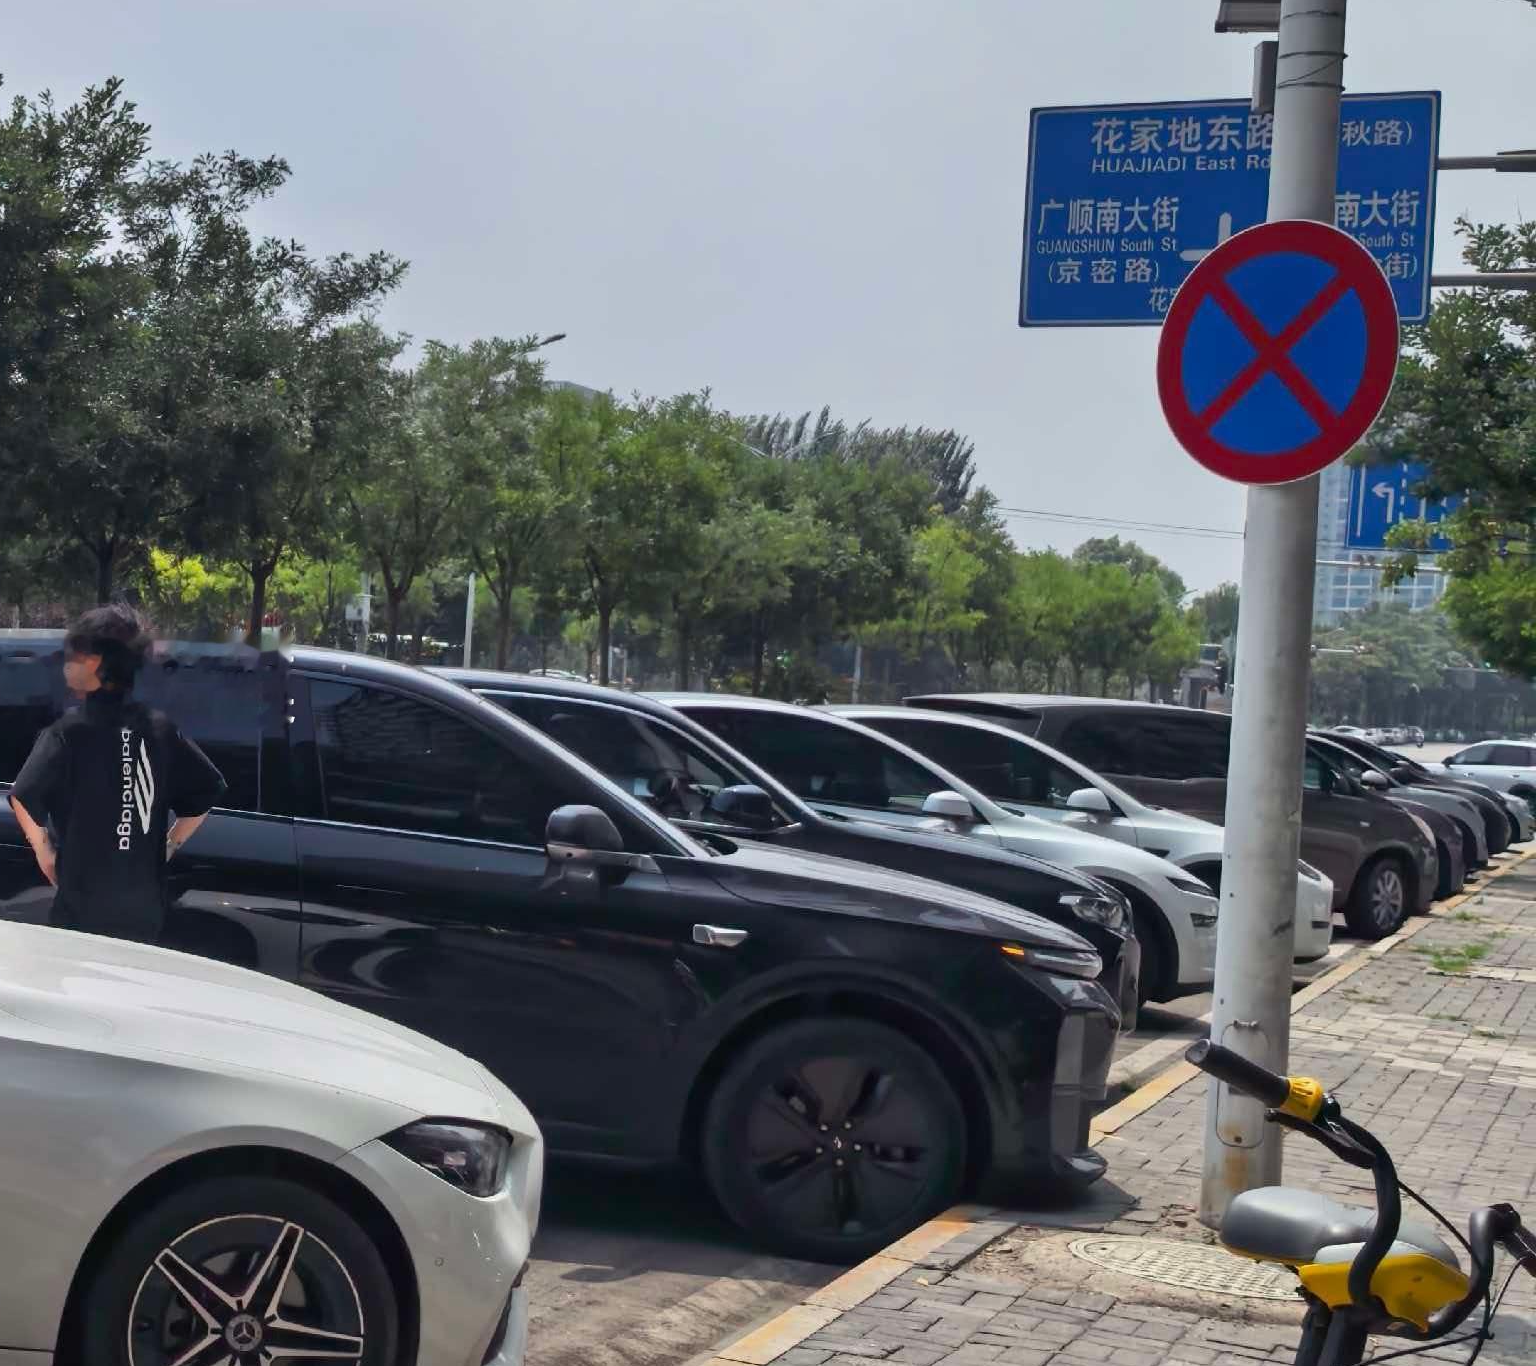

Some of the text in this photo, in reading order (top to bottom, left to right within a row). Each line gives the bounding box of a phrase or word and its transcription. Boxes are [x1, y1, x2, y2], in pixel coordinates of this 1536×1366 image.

[1091, 113, 1273, 155] 花家地东路
[1091, 156, 1187, 174] HUAJIADI
[1195, 154, 1236, 171] East
[1037, 196, 1179, 235] 广顺南大街
[1333, 188, 1420, 228] 南大街
[1036, 235, 1177, 254] GUANGSHUN South St
[1400, 232, 1415, 247] St
[1149, 285, 1179, 313] 花
[116, 726, 134, 851] balenciaga
